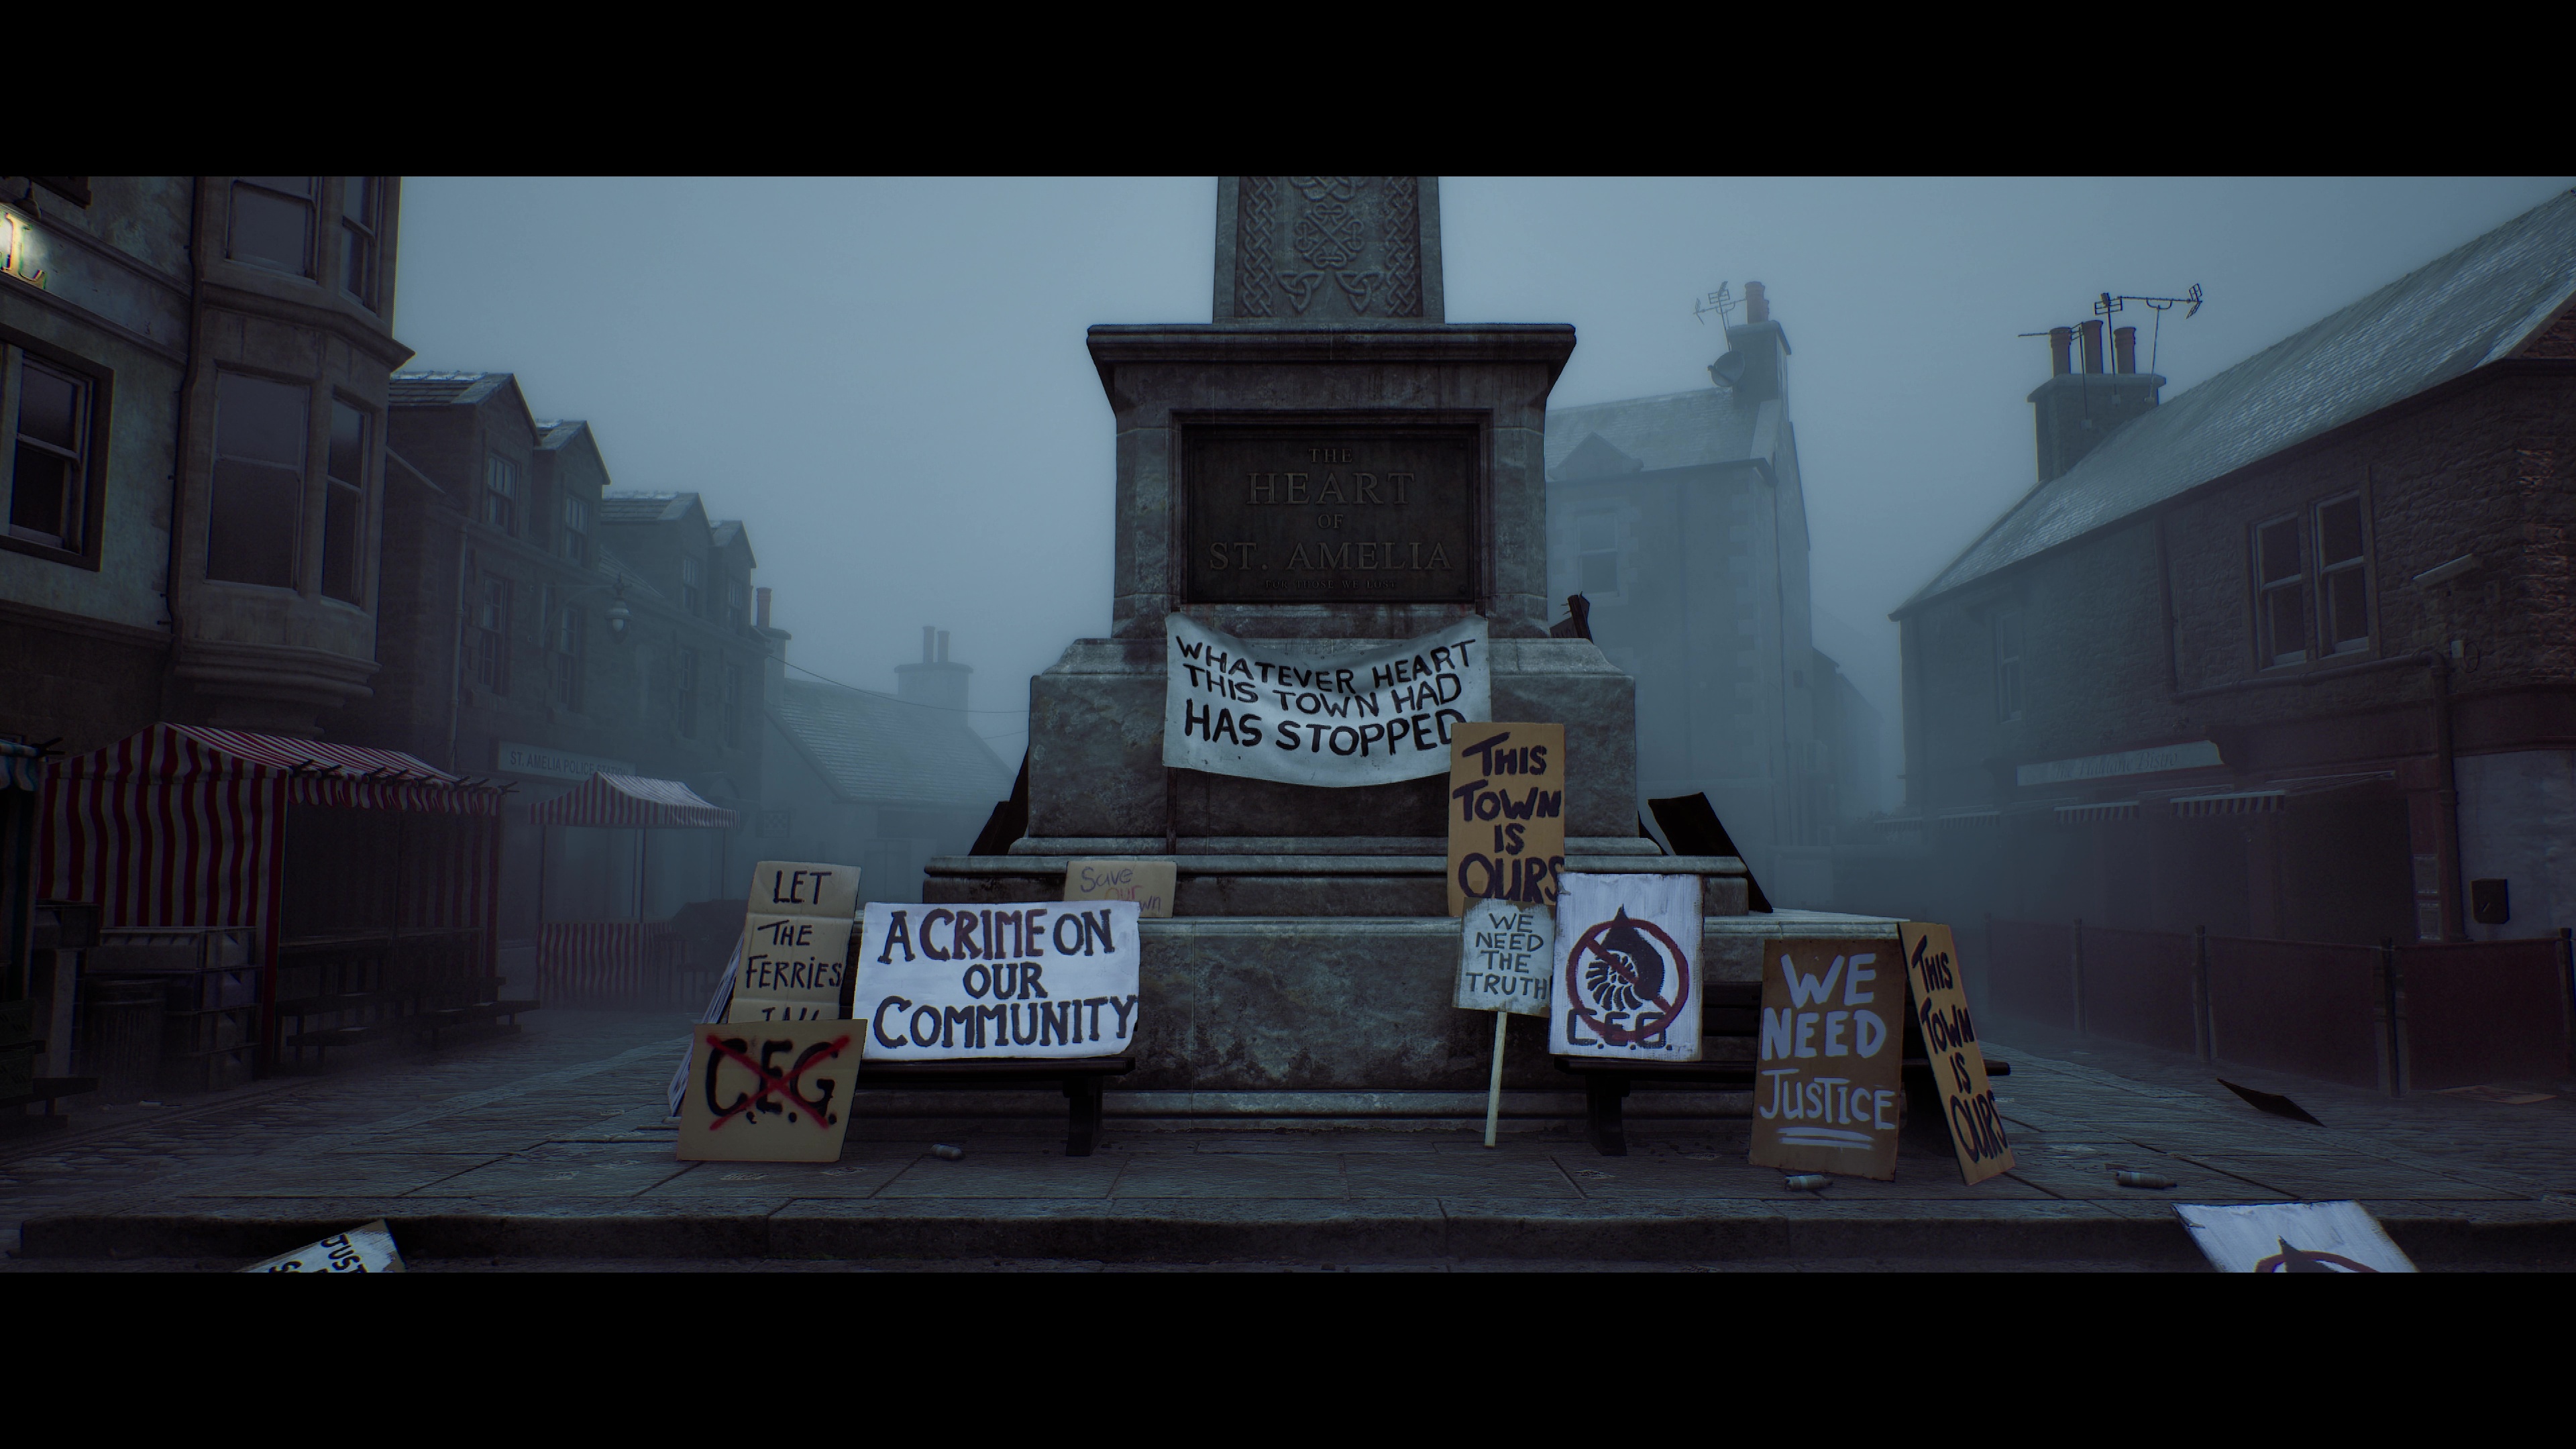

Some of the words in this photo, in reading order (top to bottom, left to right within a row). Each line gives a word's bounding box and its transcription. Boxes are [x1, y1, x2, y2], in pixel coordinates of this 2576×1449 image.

[1307, 448, 1353, 464] THE
[1246, 472, 1415, 505] HEART
[1317, 514, 1344, 529] OF
[1210, 542, 1269, 570] ST.
[1285, 542, 1454, 570] AMELIA
[1265, 580, 1288, 589] FOR
[1295, 580, 1334, 589] THOSE
[1342, 580, 1358, 589] WE
[1366, 580, 1396, 589] LOST
[1176, 636, 1356, 694] WHATEVER
[1372, 639, 1476, 688] HEART
[1183, 663, 1258, 704] THIS
[1273, 690, 1379, 718] TOWN
[1393, 674, 1462, 714] HAD
[1185, 698, 1263, 747] HAS
[1275, 709, 1467, 757] STOPPED
[511, 751, 525, 767] ST.
[527, 754, 561, 772] AMELIA
[564, 759, 594, 775] POLICE
[1462, 732, 1547, 776] THIS
[2136, 750, 2178, 771] Bistro
[1452, 779, 1561, 822] TOWN
[1494, 822, 1526, 855] IS
[773, 870, 832, 904] LET
[1080, 867, 1133, 893] Save
[1458, 852, 1564, 904] OURS
[1139, 895, 1161, 913] wn
[757, 920, 812, 946] THE
[877, 910, 916, 964] A
[919, 908, 1048, 961] CRIME
[1053, 909, 1116, 956] ON
[1476, 931, 1544, 951] NEED
[1489, 913, 1534, 933] WE
[1481, 950, 1532, 973] THE
[1912, 934, 1953, 993] THIS
[963, 961, 1049, 1000] OUR
[1465, 972, 1548, 1000] TRUTH
[1780, 953, 1877, 1009] WE
[873, 994, 1138, 1049] COMMUNITY
[1761, 1006, 1887, 1061] NEED
[1920, 997, 1975, 1054] TOWN
[1949, 1052, 1972, 1095] IS
[1758, 1068, 1896, 1130] JUSTICE
[1950, 1089, 2008, 1164] OURS
